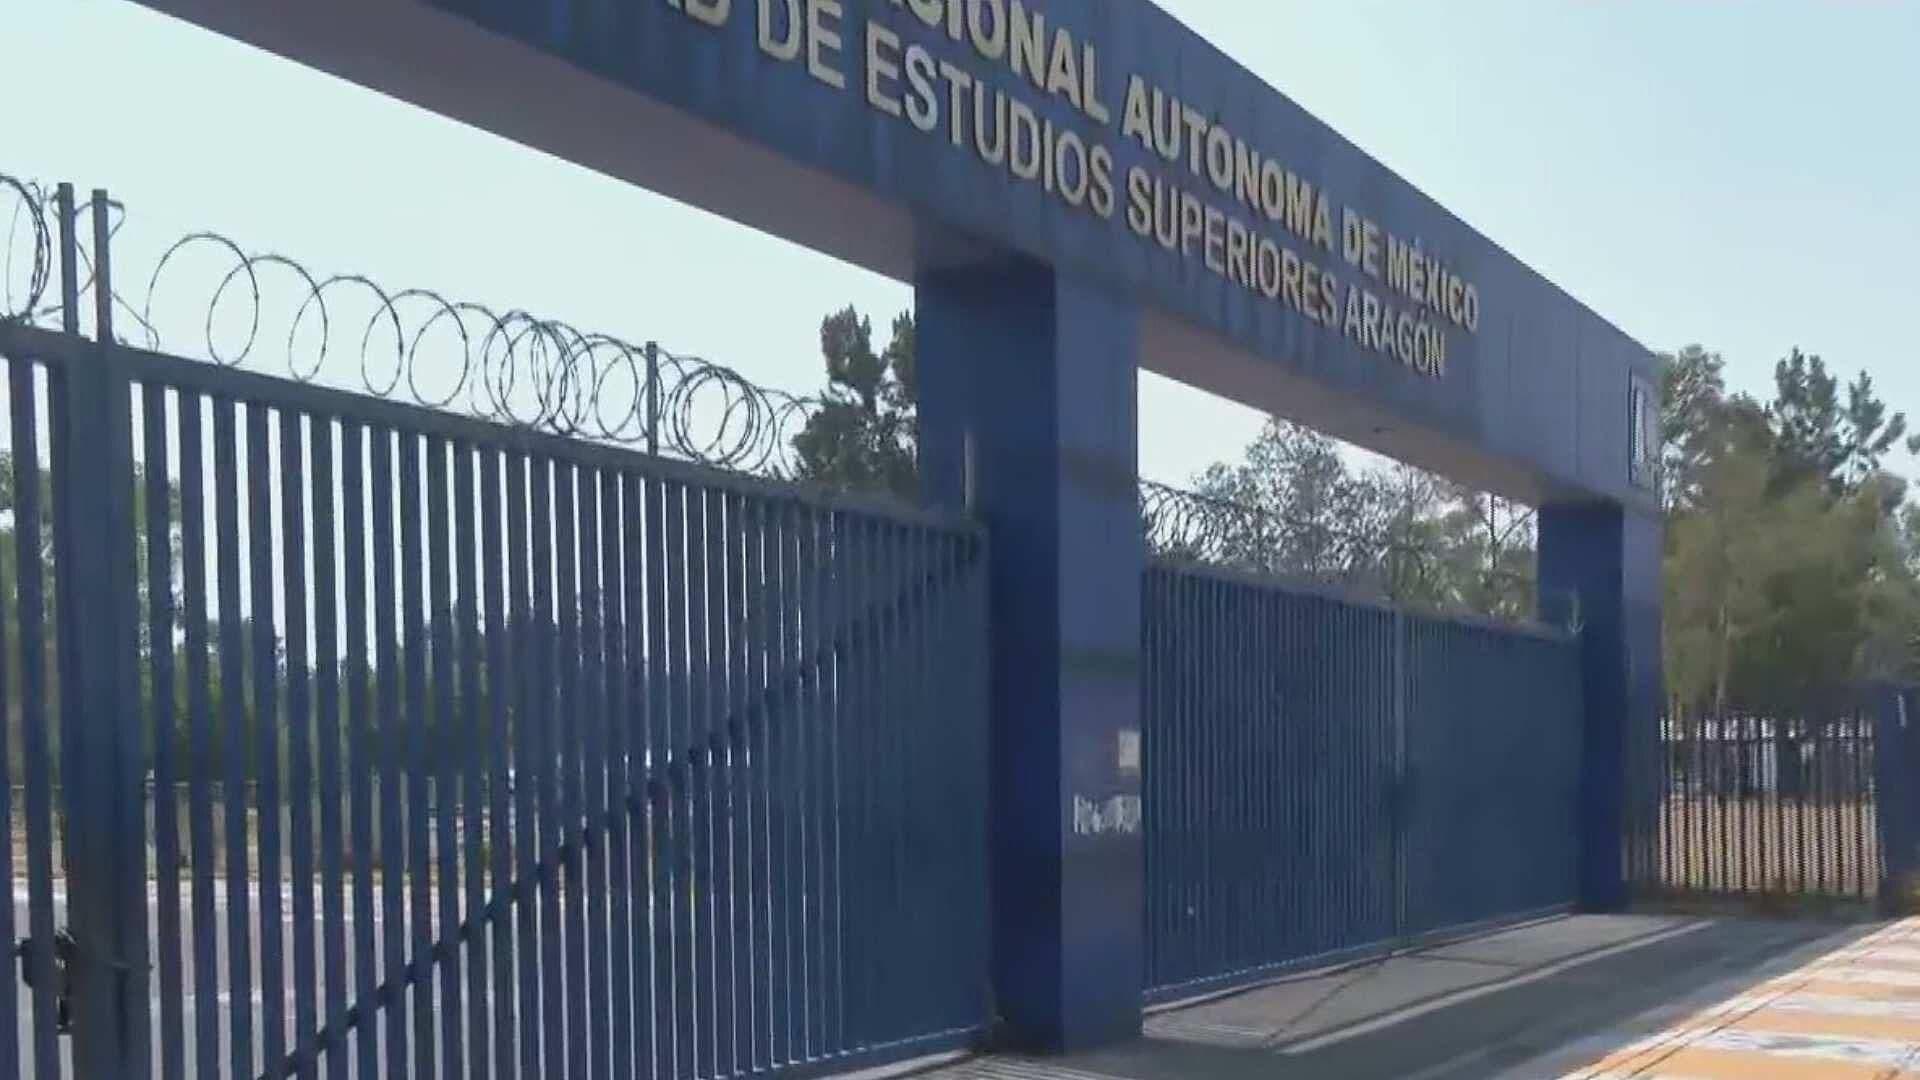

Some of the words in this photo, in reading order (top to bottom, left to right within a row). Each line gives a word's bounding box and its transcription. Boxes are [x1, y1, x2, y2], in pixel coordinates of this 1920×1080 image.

[757, 0, 846, 89] DE
[867, 21, 1113, 218] ESTUDIOS
[1127, 167, 1339, 328] SUPERIORES
[1343, 284, 1446, 378] ARAGÓN
[892, 0, 1110, 124] IONAL
[1342, 206, 1379, 277] DE
[1386, 232, 1480, 333] MÉXICO
